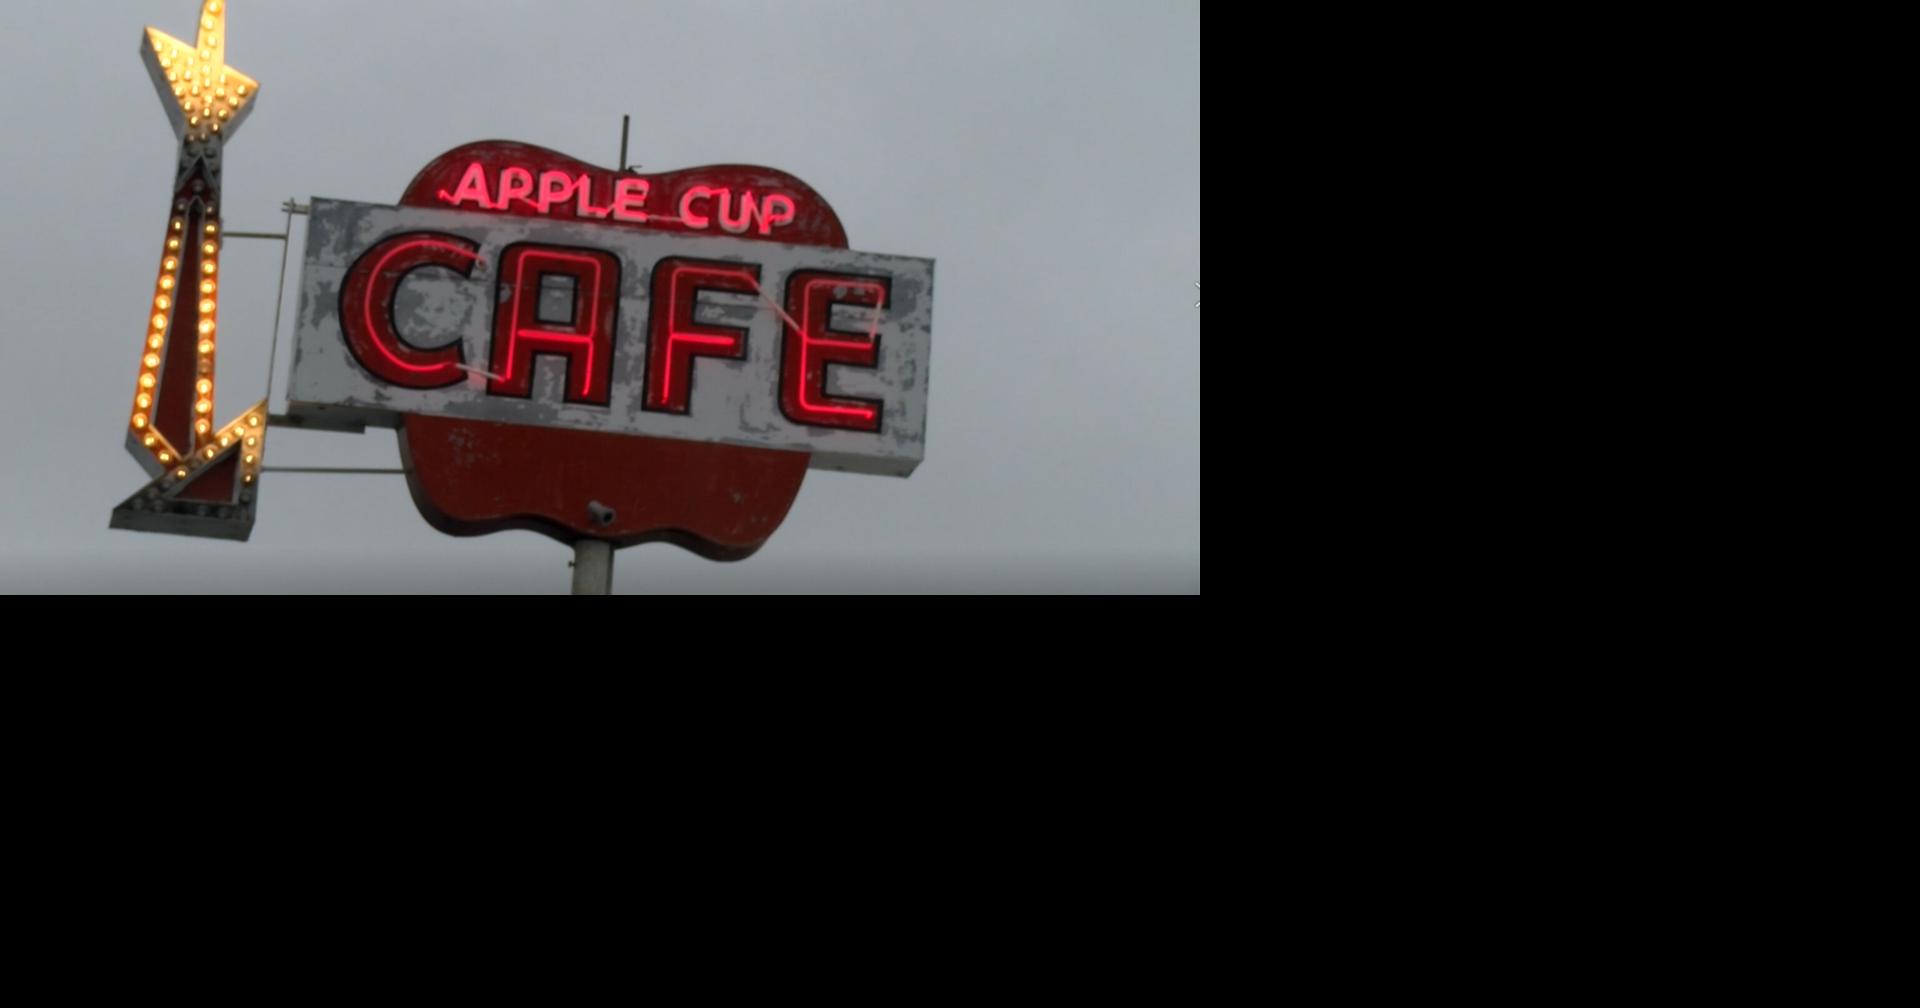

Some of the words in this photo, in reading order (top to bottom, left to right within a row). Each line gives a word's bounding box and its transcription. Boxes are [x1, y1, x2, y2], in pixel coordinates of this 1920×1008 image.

[451, 162, 649, 223] APPLE
[679, 185, 796, 235] CUP
[338, 231, 893, 434] CAFE
